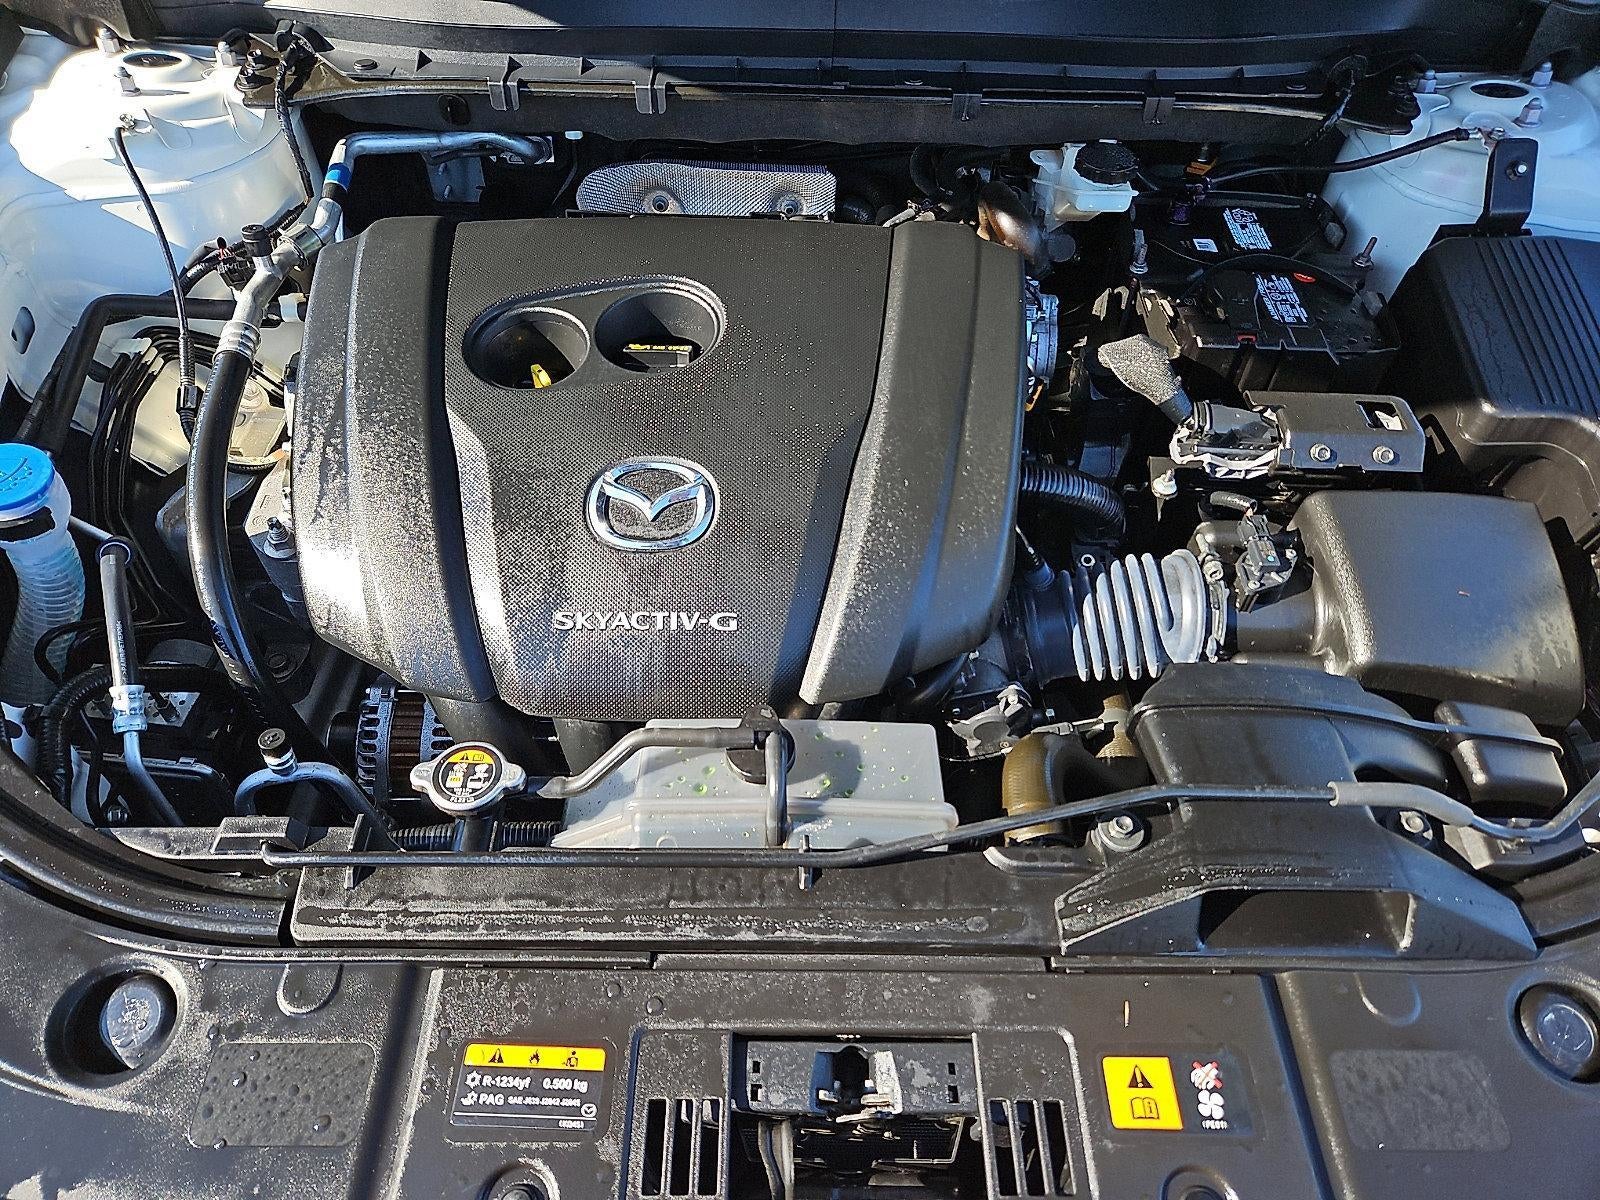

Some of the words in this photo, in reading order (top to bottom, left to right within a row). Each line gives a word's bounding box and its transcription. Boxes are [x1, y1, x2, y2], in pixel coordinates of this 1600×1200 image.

[553, 611, 738, 631] SKYACTIV-G
[481, 1075, 531, 1090] R-1234yf
[542, 1077, 572, 1090] 0.500
[573, 1078, 589, 1093] kg
[478, 1093, 505, 1106] PAG
